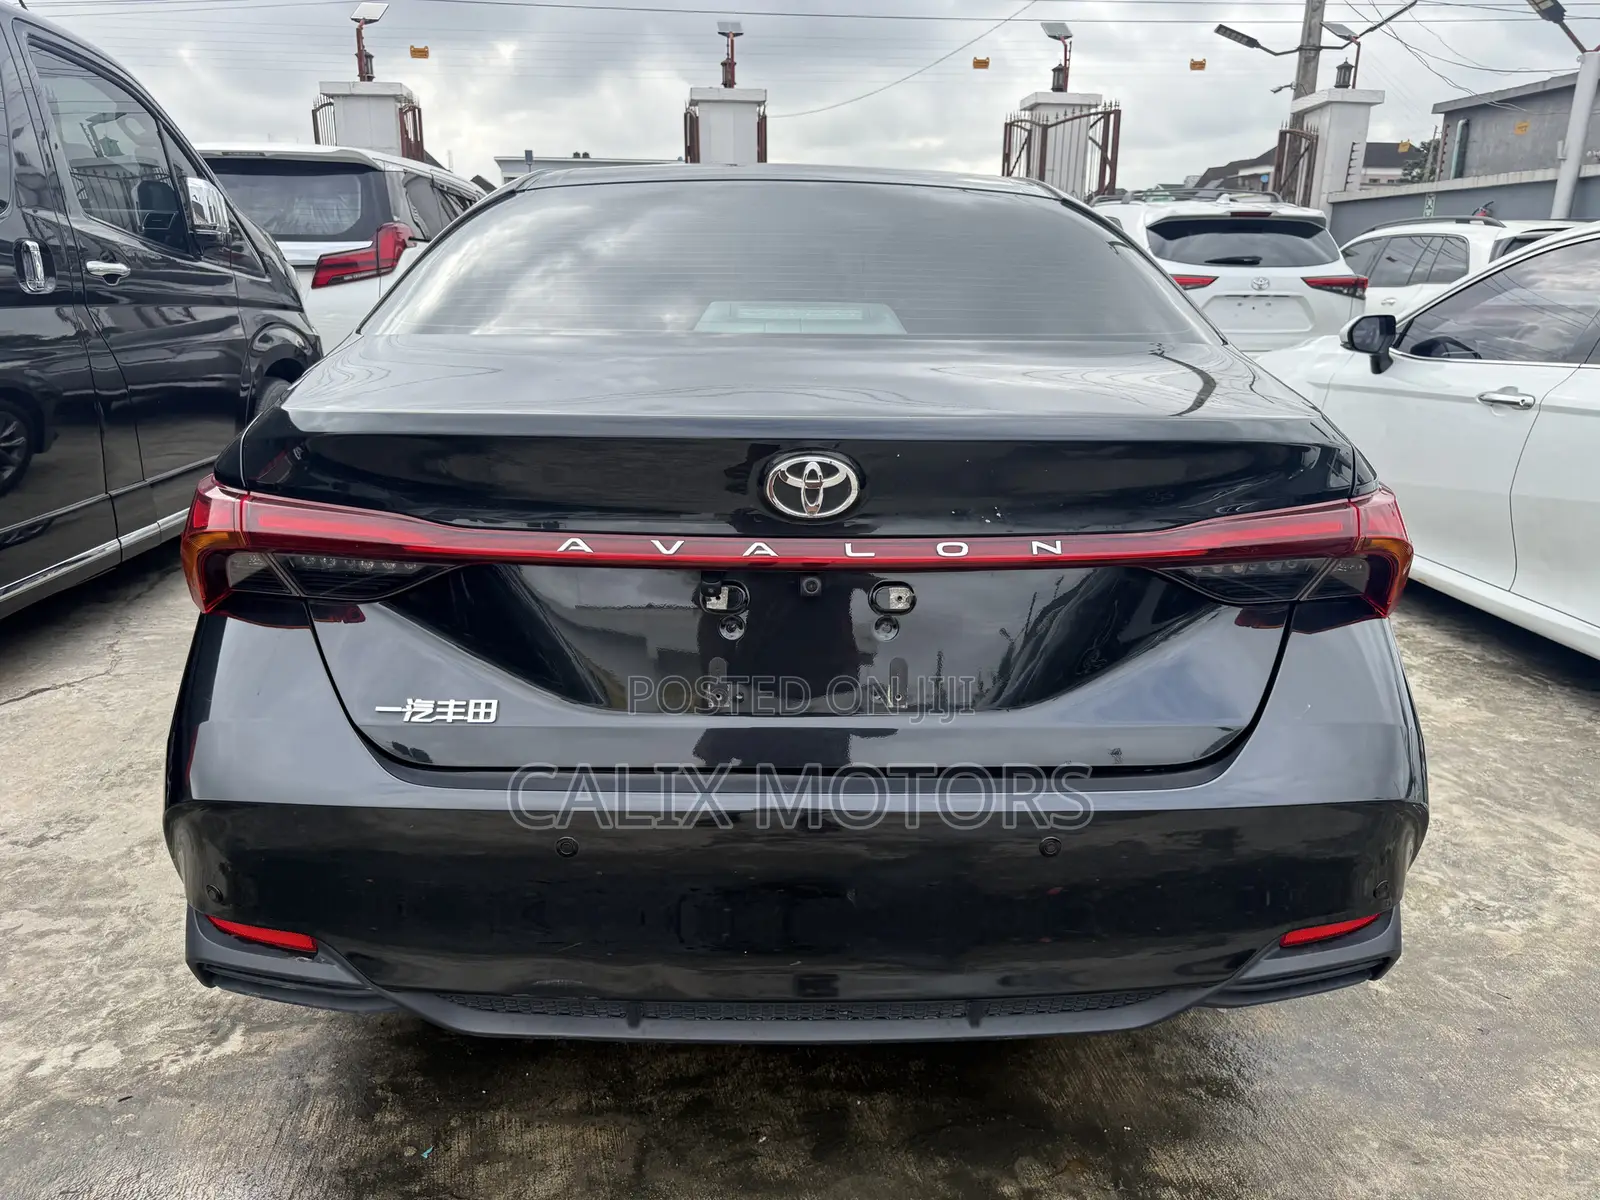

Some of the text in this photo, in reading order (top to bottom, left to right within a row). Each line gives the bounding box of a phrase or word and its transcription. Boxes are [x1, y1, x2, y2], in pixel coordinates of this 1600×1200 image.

[557, 537, 1063, 557] AVALON
[375, 698, 498, 723] 一汽丰田
